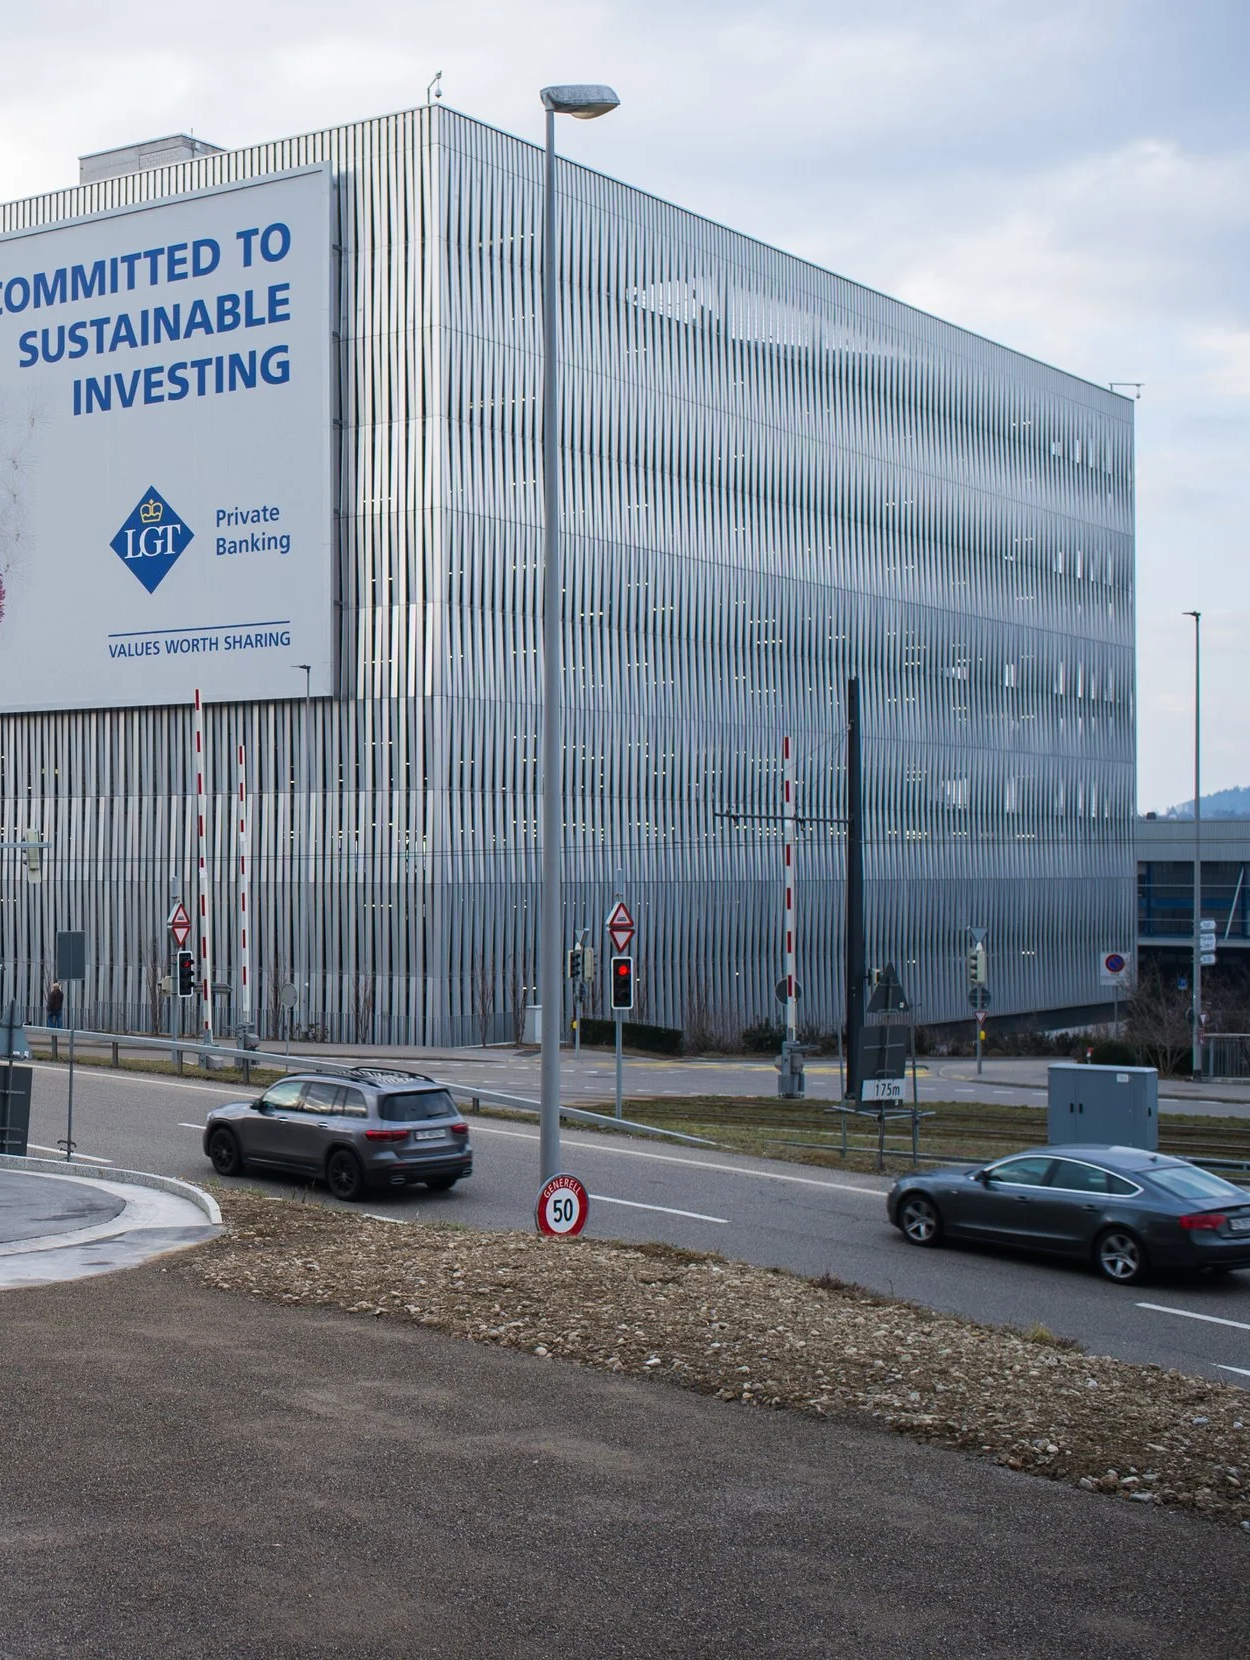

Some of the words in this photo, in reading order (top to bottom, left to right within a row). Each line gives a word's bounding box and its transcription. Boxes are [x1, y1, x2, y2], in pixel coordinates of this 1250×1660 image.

[236, 222, 291, 268] TO
[19, 282, 291, 368] SUSTAINABLE
[73, 345, 290, 416] INVESTING
[216, 505, 280, 528] Private
[124, 524, 181, 559] LGT
[216, 532, 290, 556] Banking
[108, 641, 160, 658] VALUES
[165, 637, 219, 654] WORTH
[224, 631, 291, 650] SHARING
[875, 1082, 900, 1097] 175m
[543, 1178, 581, 1198] GENERELL
[553, 1198, 573, 1223] 50
